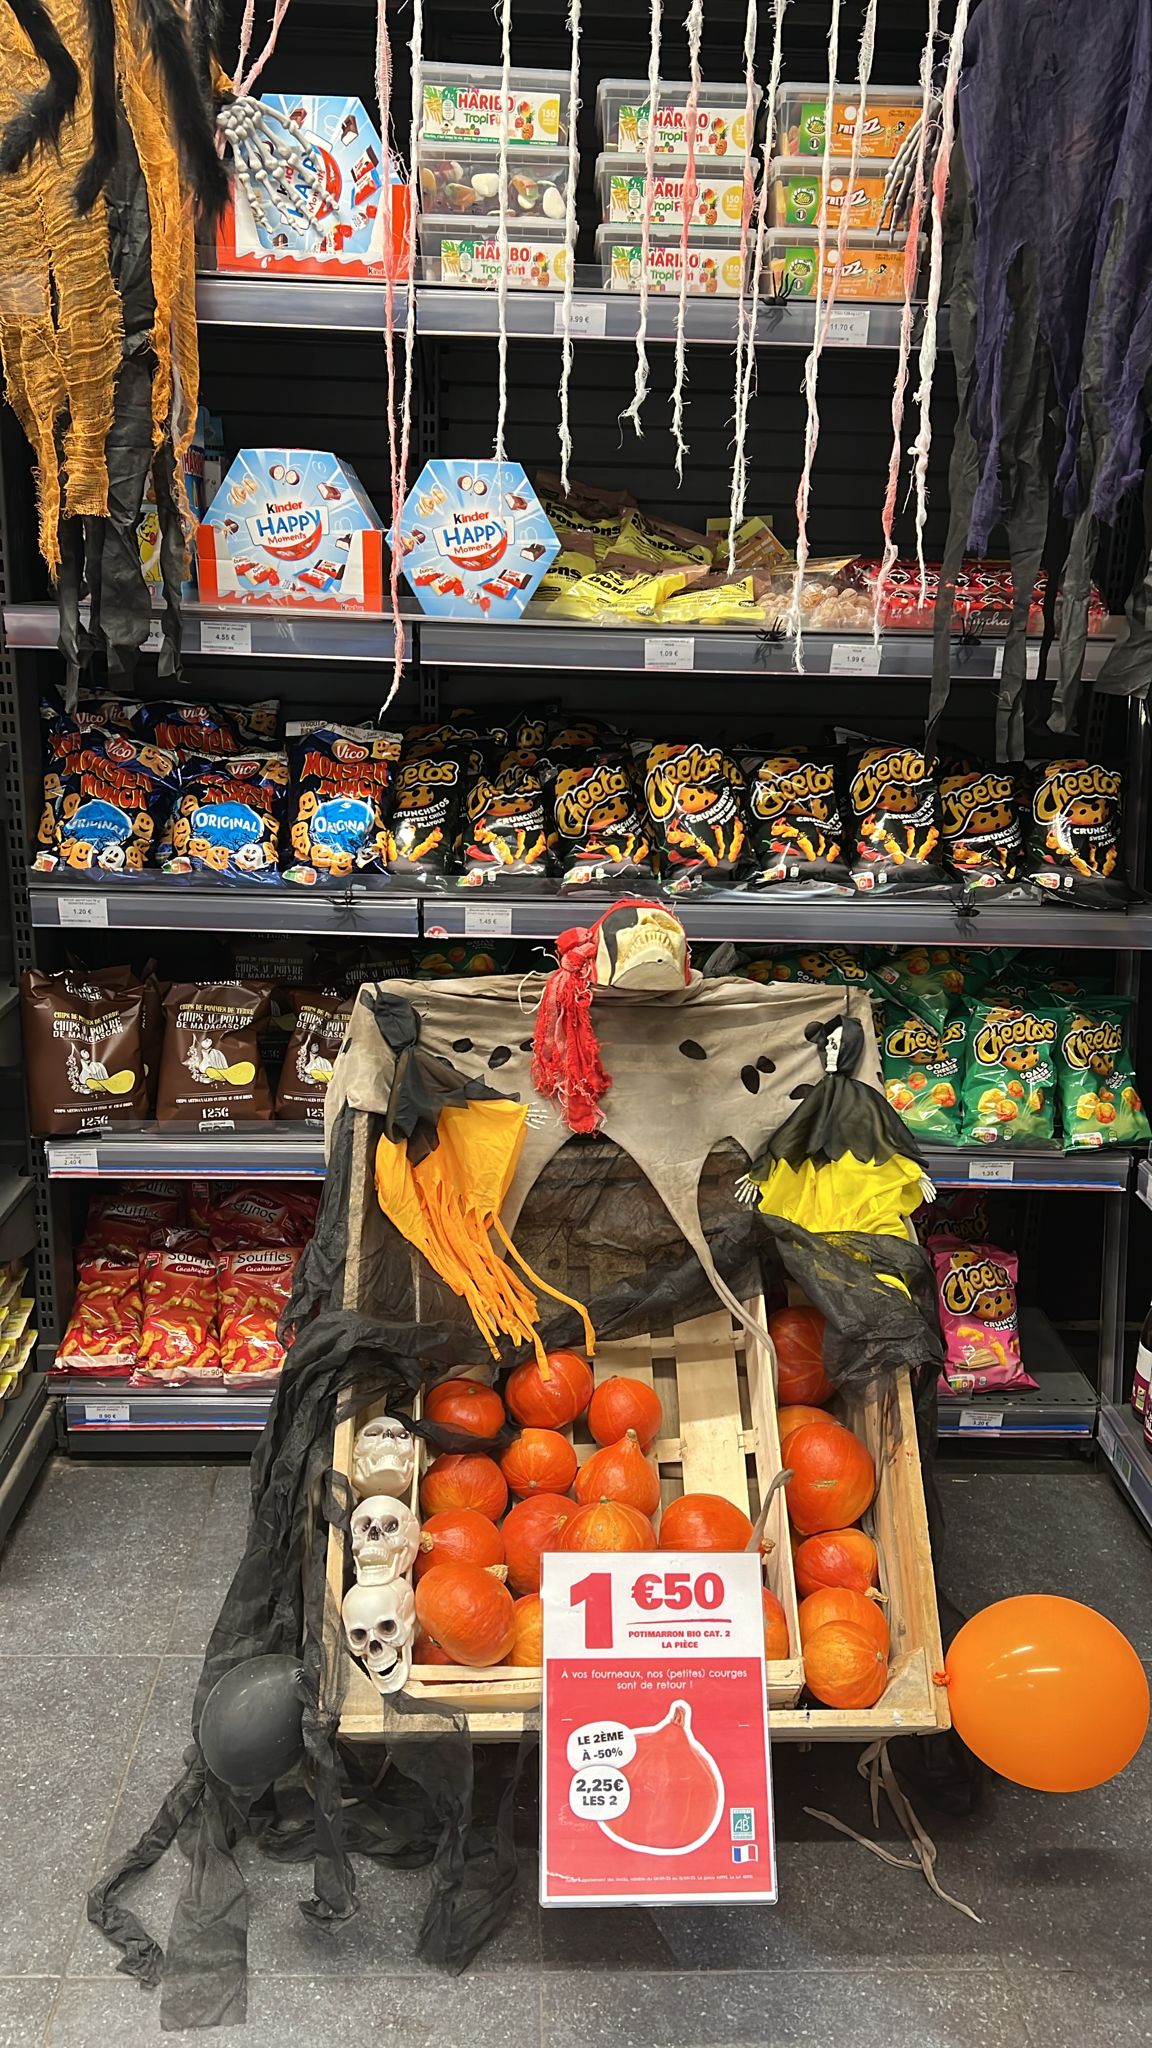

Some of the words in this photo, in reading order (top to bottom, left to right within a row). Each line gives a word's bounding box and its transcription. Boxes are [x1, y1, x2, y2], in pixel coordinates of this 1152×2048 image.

[830, 323, 848, 331] 11.70
[256, 510, 320, 537] HAPPY
[267, 533, 307, 544] Moments
[454, 543, 492, 554] Moments
[108, 742, 131, 758] Vico
[337, 745, 364, 759] Vico
[61, 750, 153, 793] MONSTER
[300, 751, 389, 787] MONSTER
[650, 750, 722, 818] Cheetos
[81, 773, 148, 811] MUNCH
[558, 769, 627, 836] Cheeto
[942, 777, 1013, 835] Cheeto
[195, 812, 258, 832] ORIGINAL
[314, 816, 366, 833] ORIGINA
[178, 1011, 204, 1022] CHIPS
[220, 1014, 254, 1026] POIVRE
[296, 1020, 306, 1028] DE
[53, 1020, 80, 1032] CHIPS
[90, 1017, 122, 1037] POIVRE
[190, 1022, 244, 1030] MADAGASC
[977, 1016, 1056, 1063] Cheetos
[925, 1058, 958, 1071] GOALS
[932, 1064, 957, 1075] CHEESE
[1020, 1062, 1049, 1080] GOALS
[201, 1107, 229, 1119] 125G
[306, 1107, 324, 1118] 125
[81, 1115, 109, 1127] 125G
[237, 1251, 292, 1263] Souffles
[570, 1572, 614, 1649] 1
[631, 1572, 725, 1611] €50
[628, 1630, 684, 1638] POTIMARRON
[686, 1630, 702, 1638] BIO
[704, 1630, 723, 1638] CAT.
[674, 1640, 698, 1649] PIÈCE
[561, 1668, 569, 1679] À
[592, 1670, 644, 1680] fourneaux,
[647, 1671, 663, 1679] nos
[666, 1668, 706, 1680] (petites)
[708, 1670, 748, 1681] courges
[617, 1682, 636, 1690] sont
[640, 1681, 652, 1689] de
[578, 1736, 591, 1746] LE
[594, 1731, 624, 1744] 2ÈME
[582, 1750, 591, 1761] À
[594, 1747, 623, 1759] -50%
[576, 1779, 624, 1794] 2,25€
[582, 1796, 606, 1806] LES
[609, 1796, 618, 1806] 2
[734, 1817, 750, 1832] AB
